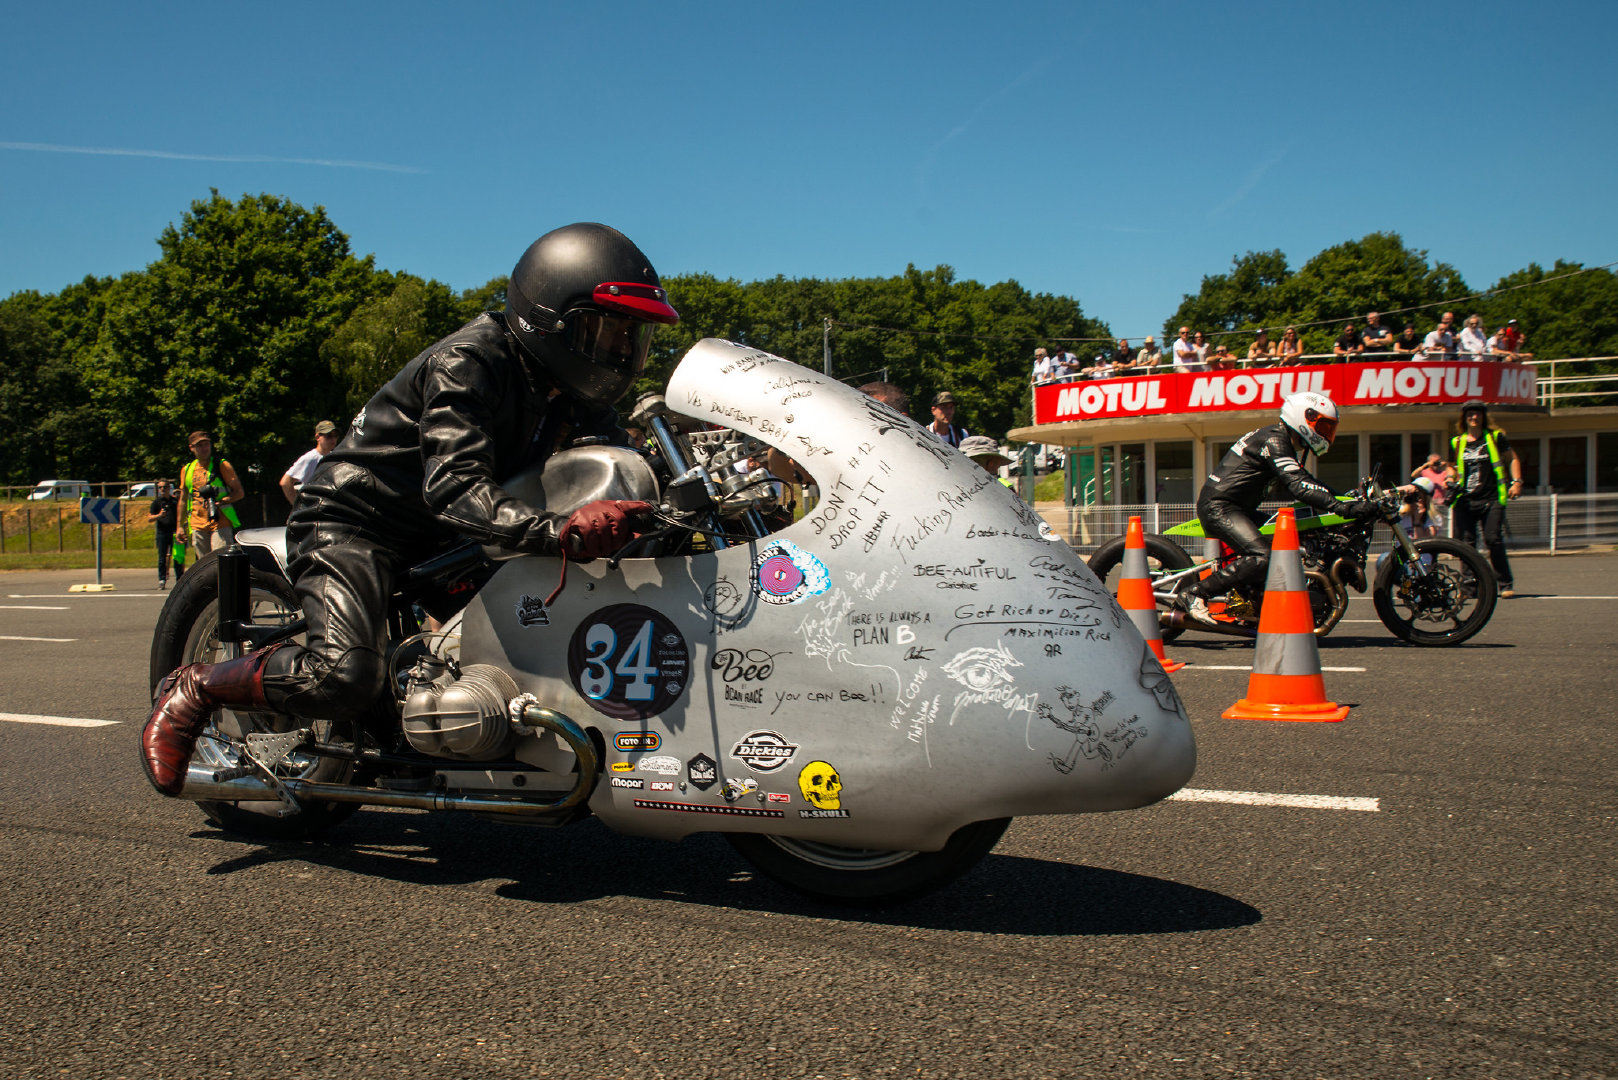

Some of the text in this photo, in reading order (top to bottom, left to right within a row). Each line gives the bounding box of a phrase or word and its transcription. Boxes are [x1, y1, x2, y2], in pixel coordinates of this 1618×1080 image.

[1056, 380, 1167, 417] MOTUL
[1188, 371, 1332, 408] MOTUL
[1354, 367, 1484, 399] MOTUL
[811, 473, 854, 535] DON'T
[831, 507, 865, 549] DROP
[955, 604, 996, 619] Get
[1001, 604, 1032, 617] Rich
[1038, 609, 1054, 617] or
[853, 624, 916, 647] PLAN B
[580, 620, 660, 701] 34
[711, 648, 792, 682] Bee
[807, 691, 834, 702] CAN
[738, 746, 792, 757] Dickies
[611, 777, 644, 789] mopar
